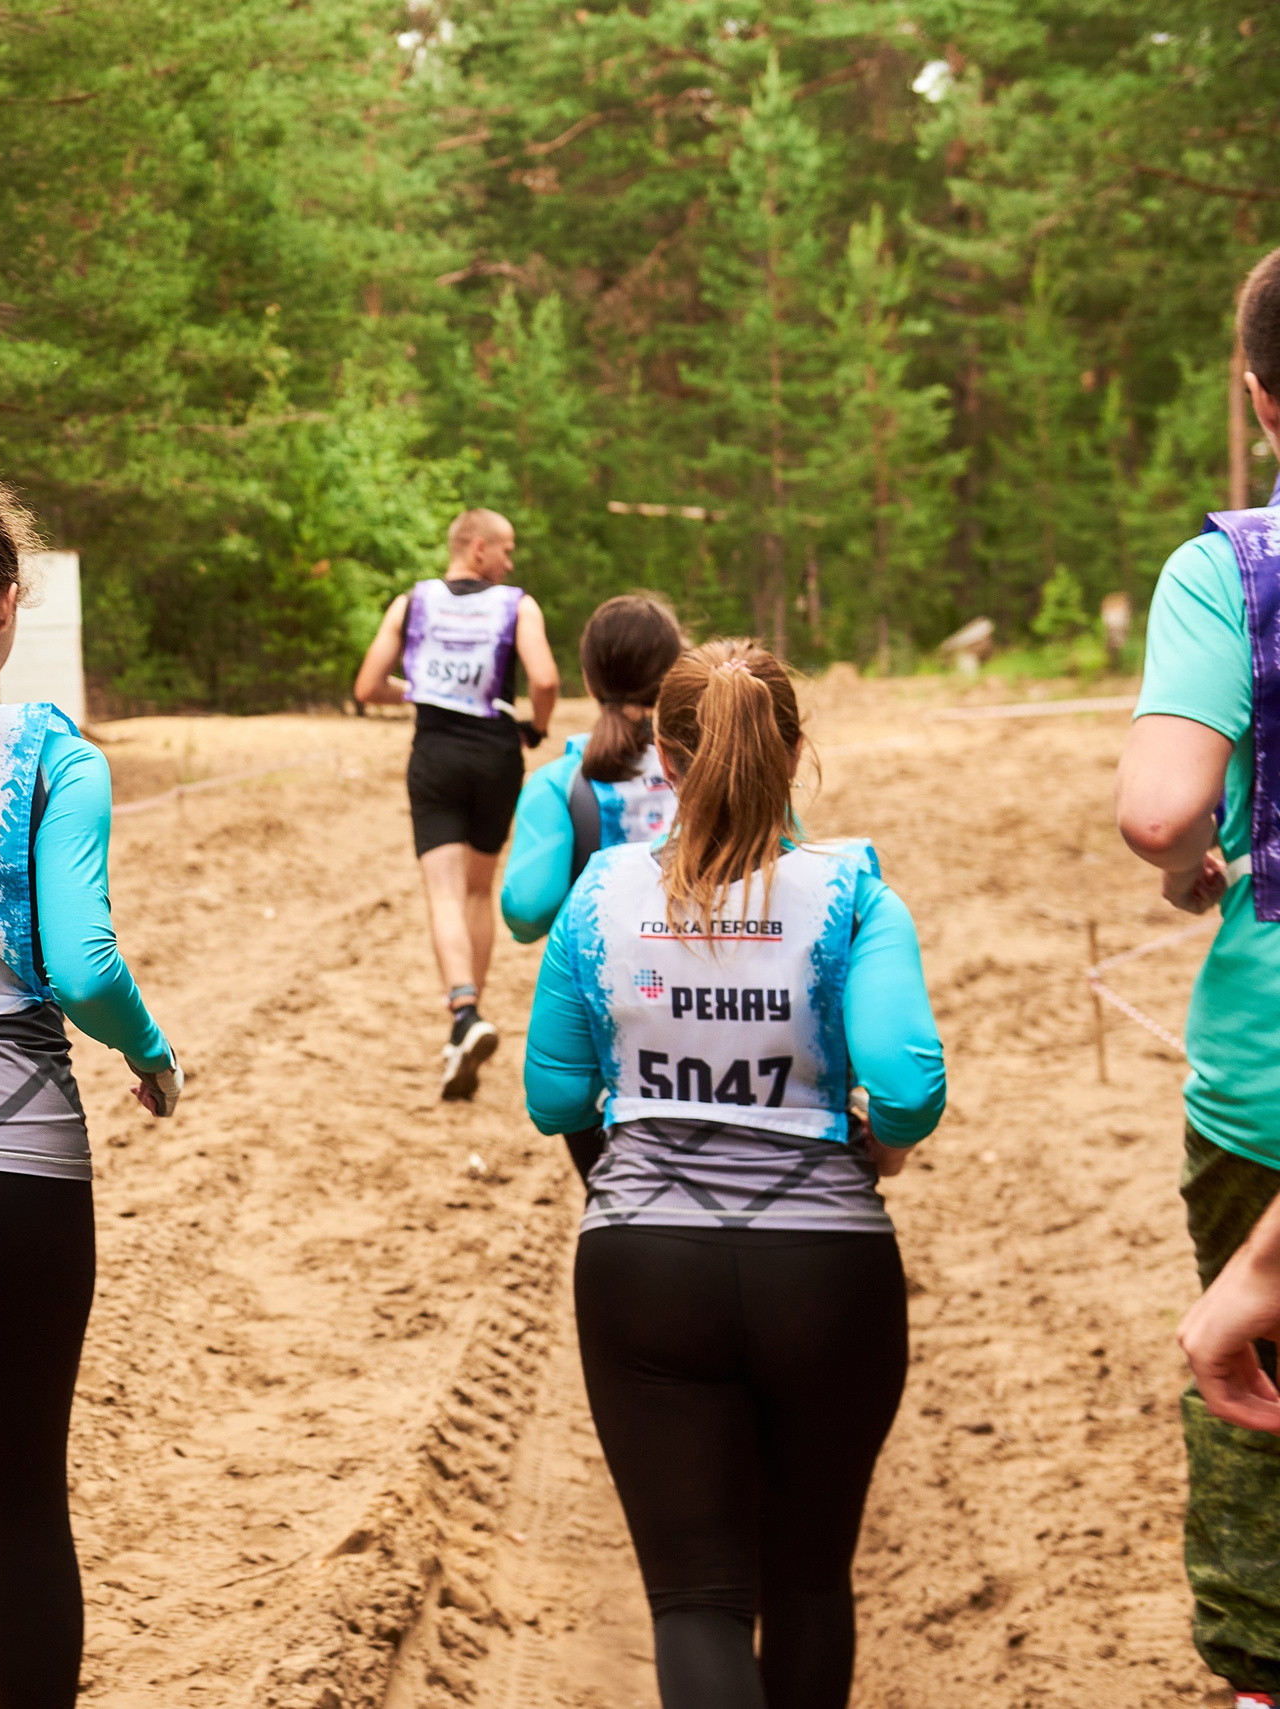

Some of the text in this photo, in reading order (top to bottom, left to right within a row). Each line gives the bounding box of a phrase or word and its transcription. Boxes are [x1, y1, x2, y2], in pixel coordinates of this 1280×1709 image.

[709, 919, 783, 935] ГЕРОЕВ
[671, 986, 792, 1022] РЕХАУ
[638, 1048, 794, 1108] 5047
